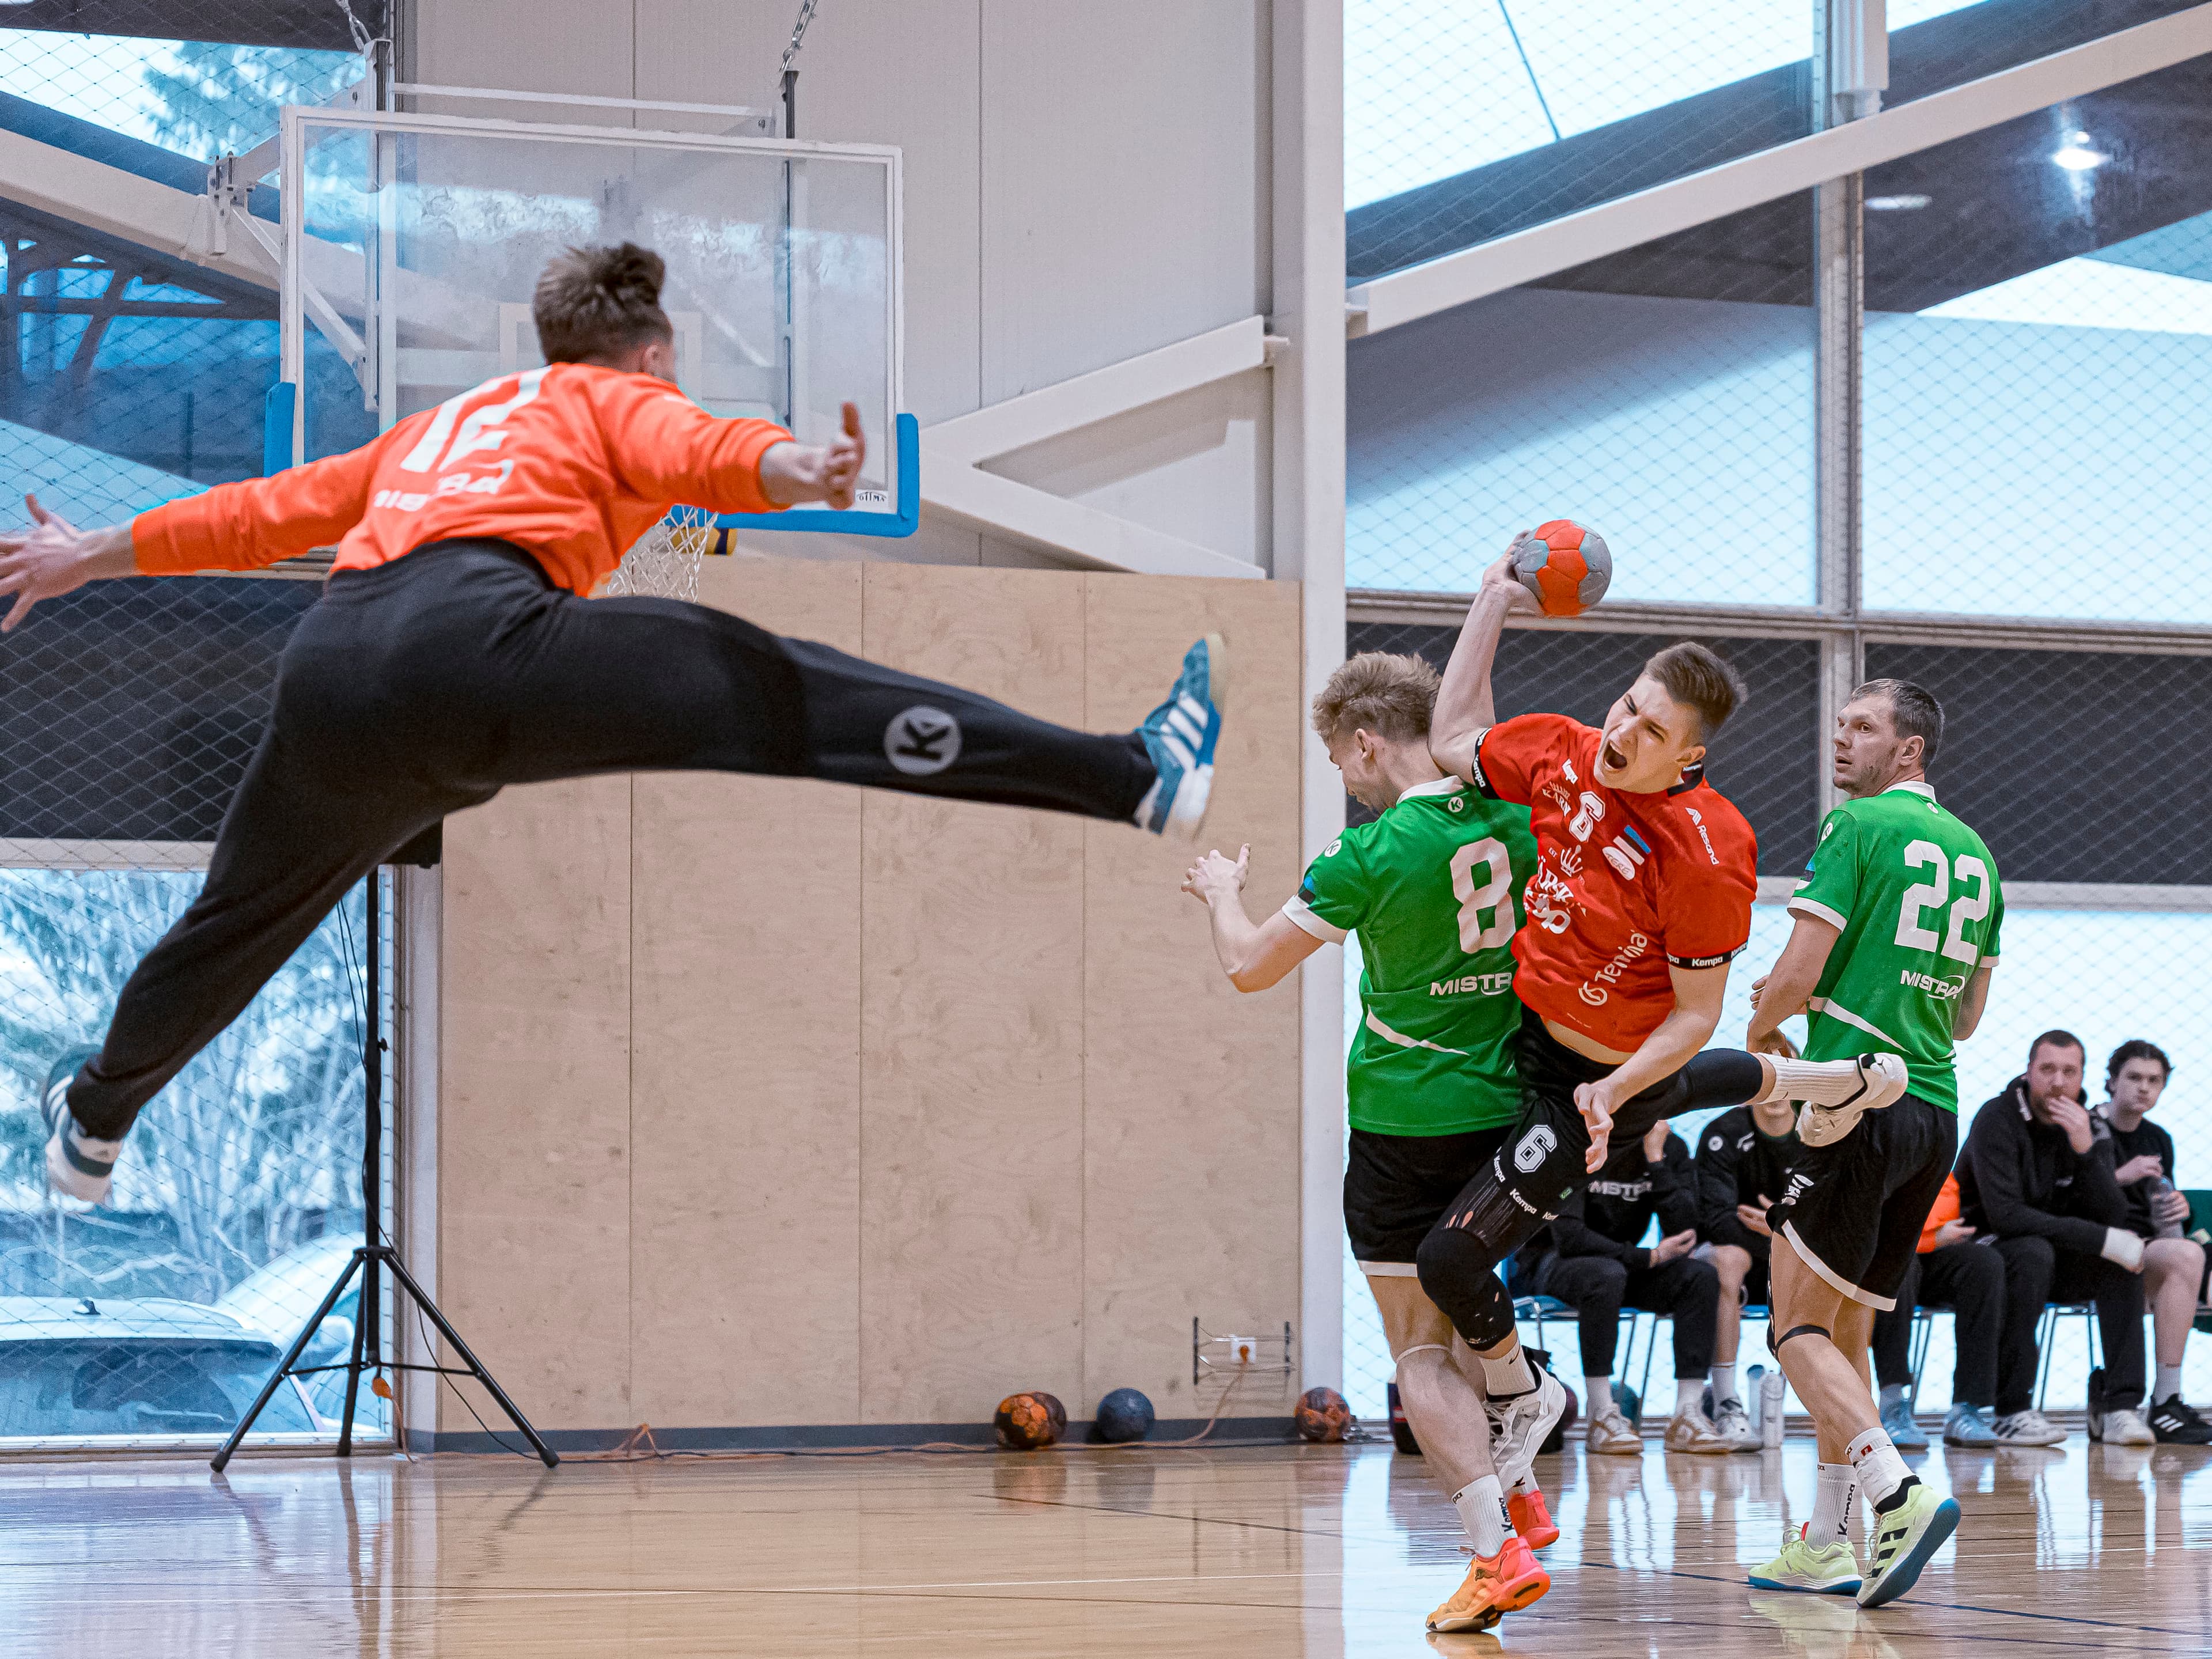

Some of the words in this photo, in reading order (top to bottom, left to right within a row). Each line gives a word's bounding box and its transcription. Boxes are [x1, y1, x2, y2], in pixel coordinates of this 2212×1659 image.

[1569, 791, 1605, 842] 6
[1697, 825, 1719, 865] Resand
[1450, 837, 1516, 954] 8
[1895, 839, 1990, 965] 22
[1692, 956, 1724, 967] Kempa
[1430, 972, 1512, 996] MISTR
[1514, 1124, 1557, 1173] 6
[1509, 1188, 1537, 1215] Kempa
